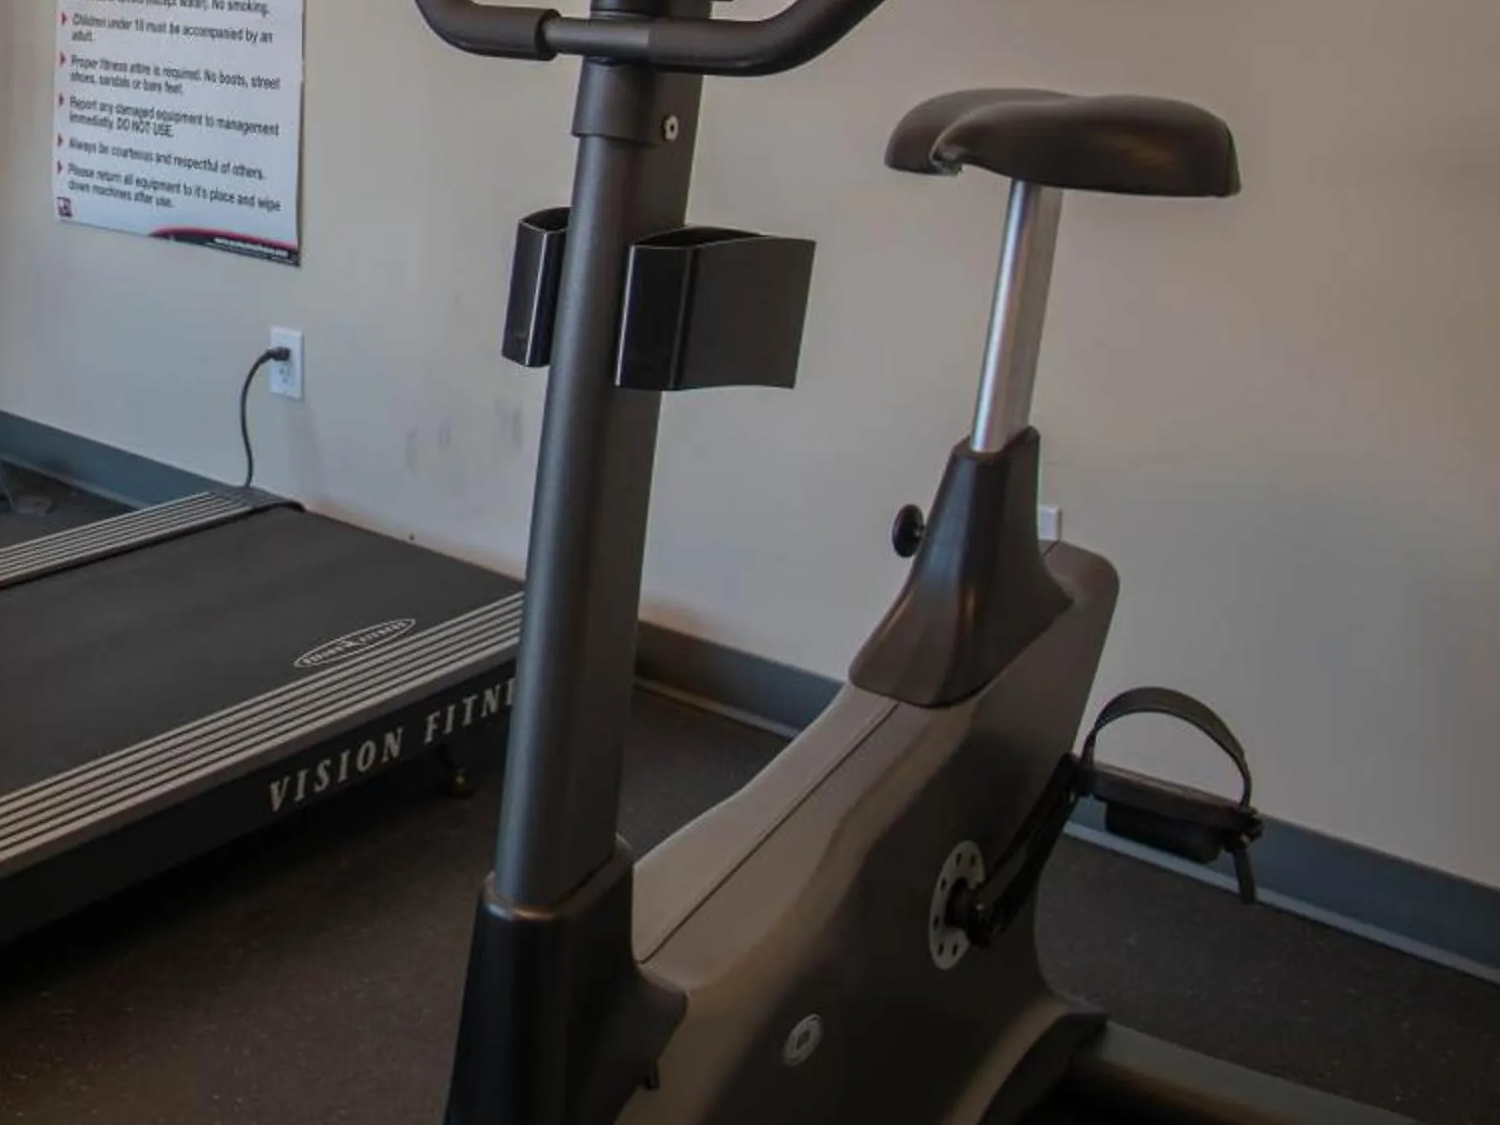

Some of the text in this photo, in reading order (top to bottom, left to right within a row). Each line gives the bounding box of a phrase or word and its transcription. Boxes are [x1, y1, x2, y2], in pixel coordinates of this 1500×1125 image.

[73, 13, 106, 28] Children
[108, 18, 132, 30] under
[146, 21, 167, 33] must
[183, 26, 243, 41] accompanied
[245, 27, 259, 43] by
[260, 32, 273, 43] an
[71, 54, 99, 70] Proper
[100, 59, 128, 72] fitness
[204, 69, 217, 83] No
[219, 70, 249, 88] boots,
[251, 75, 281, 90] street
[143, 79, 162, 92] bare
[70, 96, 98, 111] Report
[99, 102, 113, 115] any
[115, 103, 155, 119] damaged
[156, 109, 203, 127] equipment
[216, 117, 280, 138] management
[116, 117, 131, 131] DO
[132, 119, 151, 134] NOT
[69, 137, 97, 153] Always
[112, 146, 154, 161] courteous
[156, 152, 173, 165] and
[174, 156, 220, 173] respectful
[68, 162, 95, 178] Please
[135, 177, 181, 194] equipment
[209, 188, 235, 203] place
[237, 194, 255, 207] and
[257, 197, 281, 212] wipe
[92, 184, 133, 201] machines
[268, 678, 515, 813] VISION FITN
